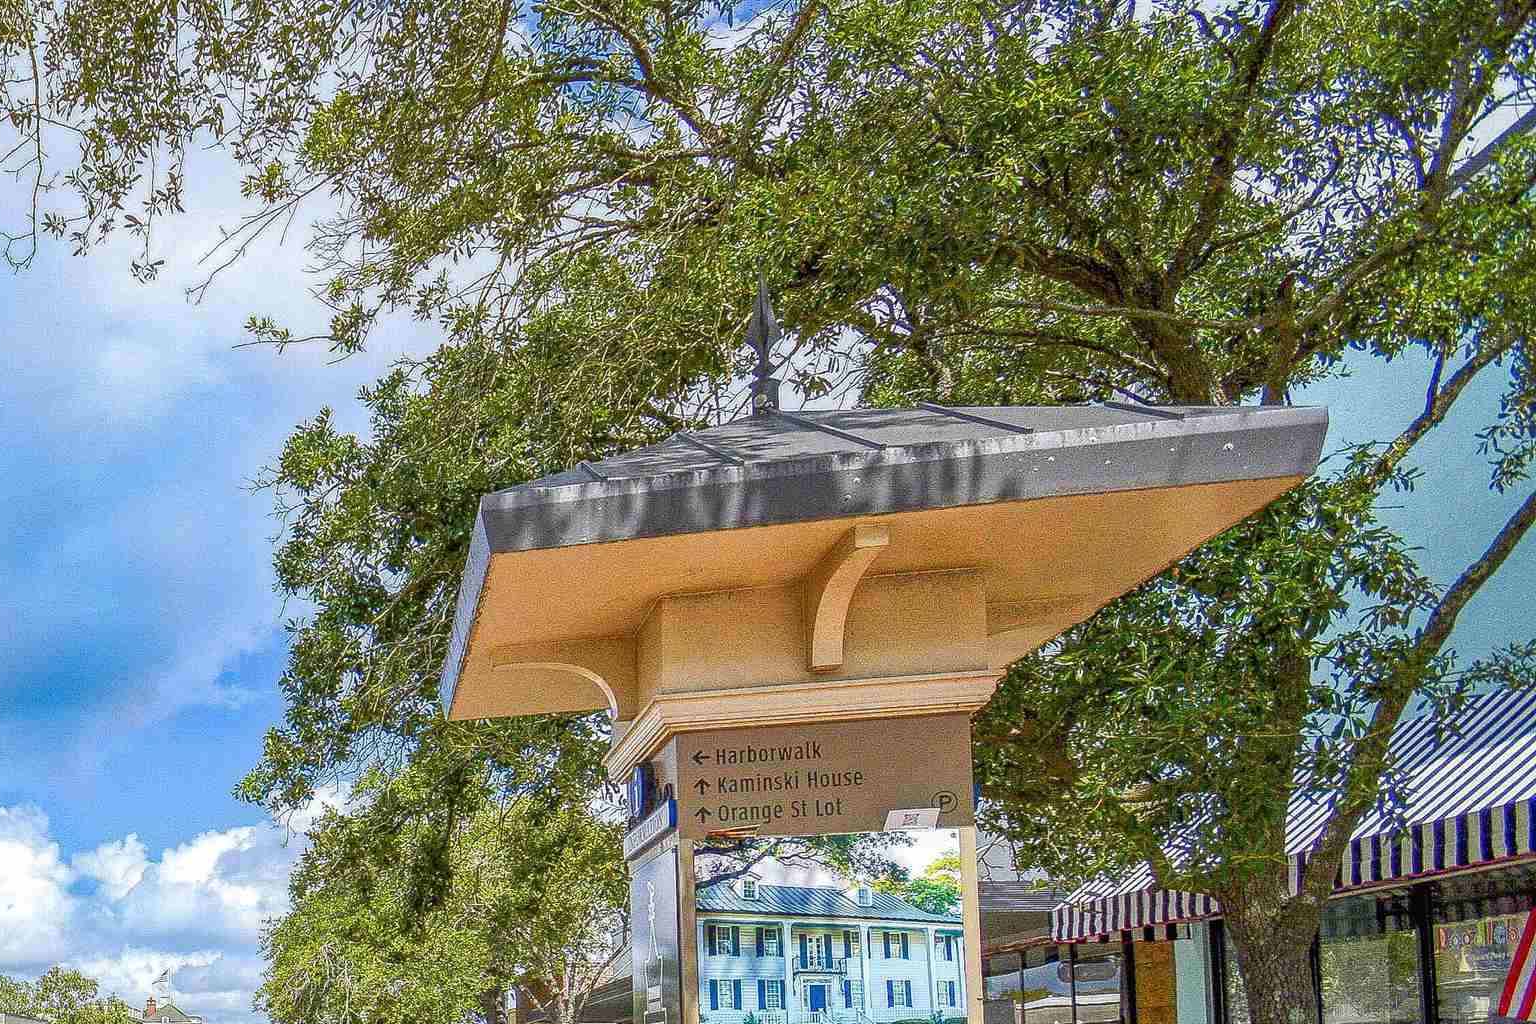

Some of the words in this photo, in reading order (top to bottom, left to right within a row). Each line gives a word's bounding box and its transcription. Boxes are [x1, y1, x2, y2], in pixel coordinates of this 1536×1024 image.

[716, 741, 822, 765] Harborwalk
[718, 770, 799, 794] Kaminski
[807, 770, 864, 789] House
[718, 803, 784, 825] Orange
[791, 801, 807, 818] St
[815, 799, 842, 817] Lot
